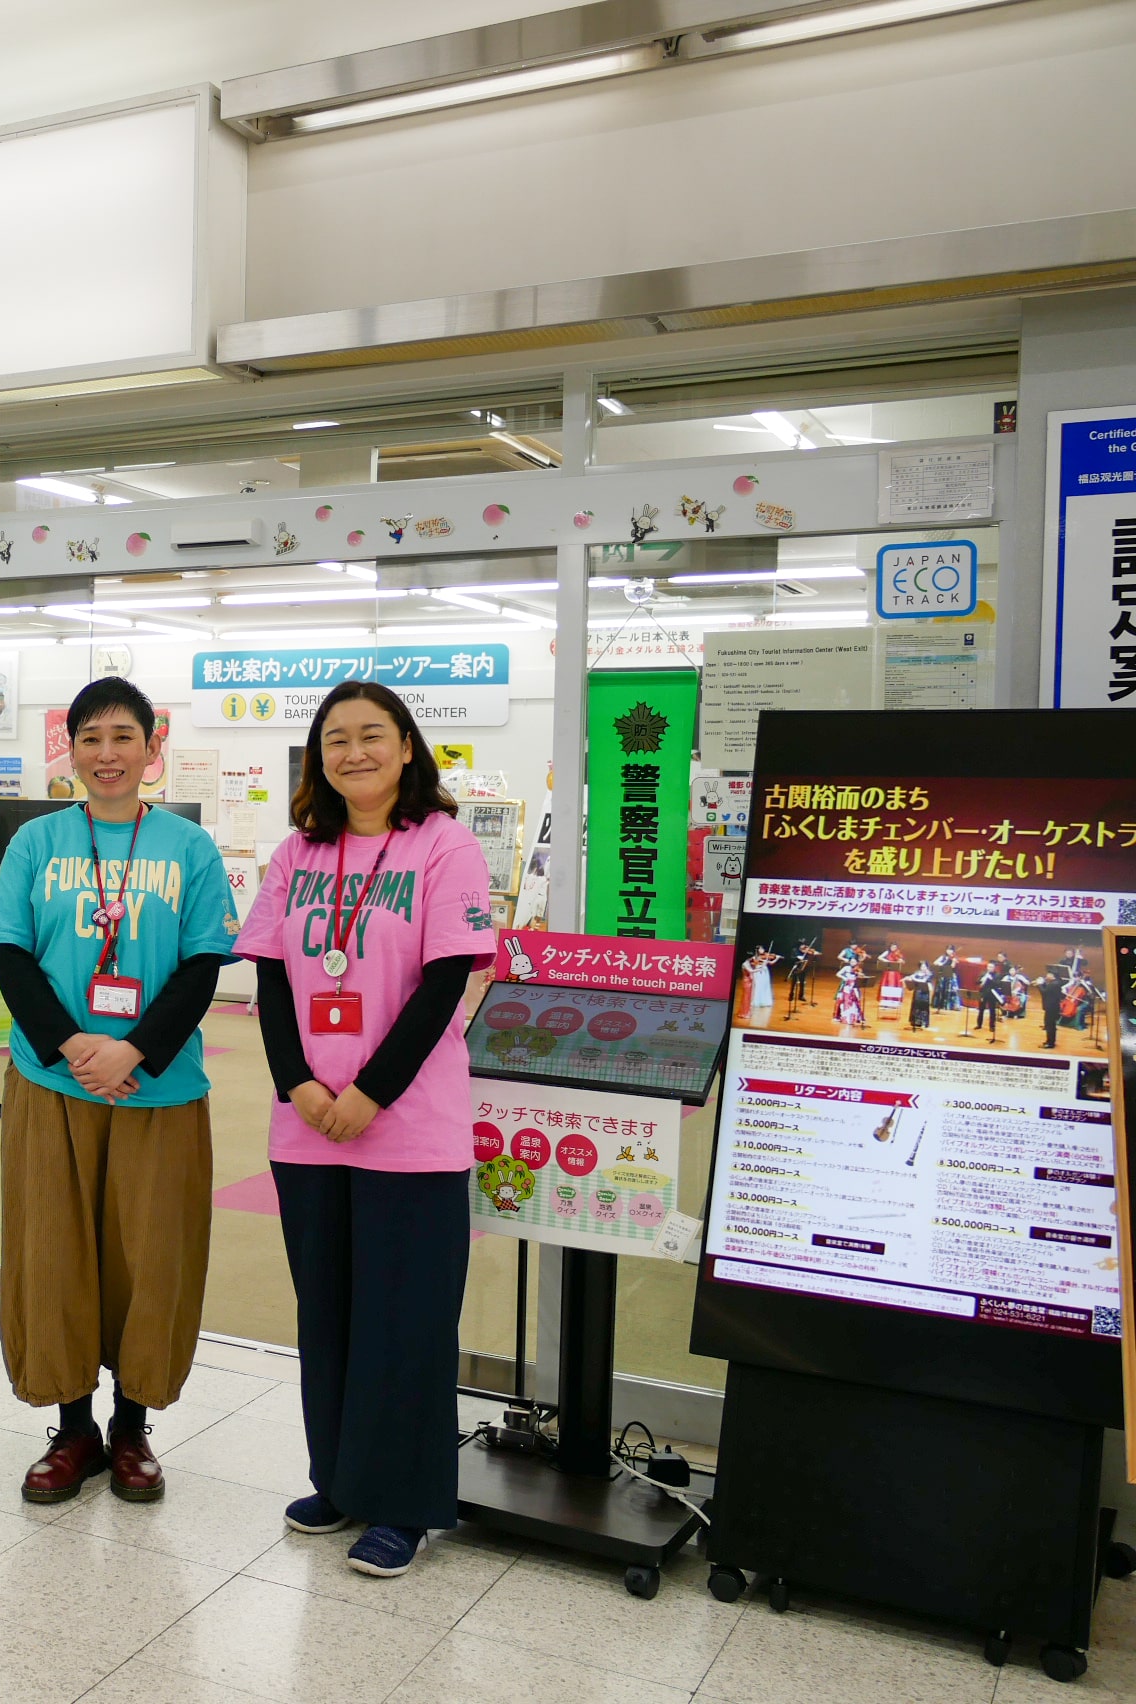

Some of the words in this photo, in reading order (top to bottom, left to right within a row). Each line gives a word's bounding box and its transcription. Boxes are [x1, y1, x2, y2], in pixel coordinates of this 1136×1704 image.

[1108, 442, 1127, 453] the
[893, 553, 961, 567] JAPAN
[893, 566, 959, 593] ECO
[893, 592, 959, 606] TRACK
[203, 652, 494, 683] 観光案内・バリアフリーツアー案内
[284, 695, 325, 706] TOURIS
[415, 707, 467, 718] CENTER
[634, 724, 647, 737] 防
[765, 784, 929, 810] 古関裕而のまち
[844, 848, 1055, 879] を盛り上げたい!
[45, 856, 181, 914] FUKUSHIMA
[758, 882, 1105, 909] 音楽堂を拠点に活動する「ふくしまチェンバー・オーケストラ」支援の
[541, 944, 717, 978] タッチパネルで検索
[548, 969, 588, 982] Search
[592, 974, 606, 983] on
[610, 973, 629, 986] the
[632, 975, 666, 989] touch
[669, 980, 703, 992] panel
[507, 988, 712, 1016] タッチで検索できます
[546, 1021, 570, 1030] 案内
[860, 1045, 947, 1059] このプロジェクトについて
[794, 1085, 862, 1101] リターン内容
[477, 1101, 658, 1138] タッチで検索できます
[520, 1135, 541, 1148] 温泉
[519, 1148, 541, 1161] 案内
[560, 1146, 593, 1157] オススメ
[568, 1156, 584, 1167] 情報
[557, 1207, 577, 1215] クイズ
[596, 1210, 616, 1219] クイズ
